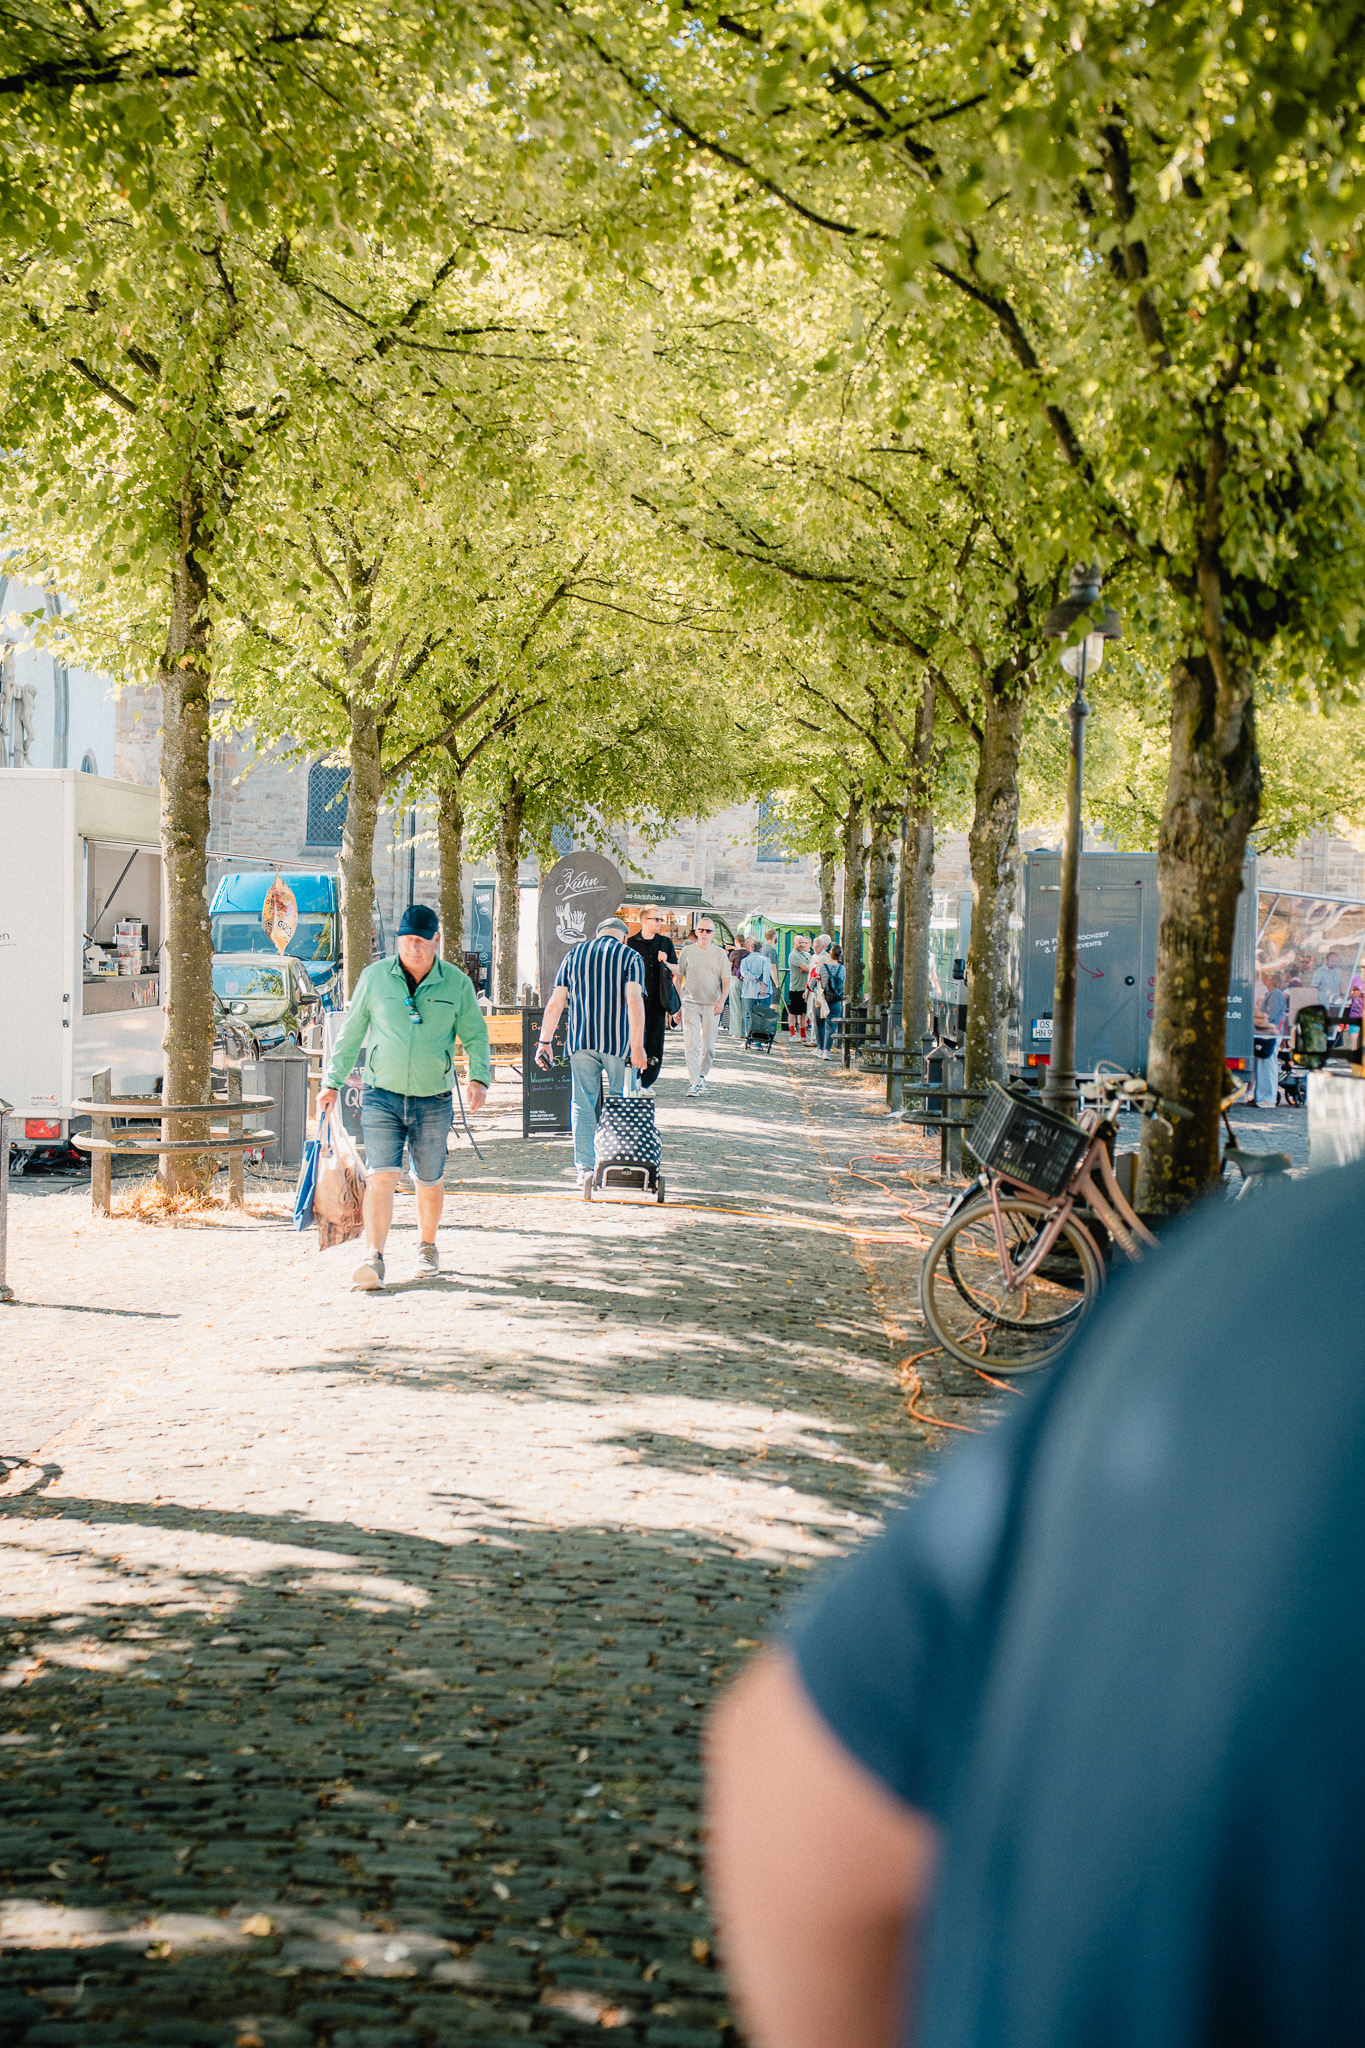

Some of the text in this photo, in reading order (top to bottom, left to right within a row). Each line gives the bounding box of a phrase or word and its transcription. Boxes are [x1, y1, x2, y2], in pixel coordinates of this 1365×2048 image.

[476, 893, 490, 904] MOIN
[1035, 939, 1050, 947] FÜR
[1040, 1020, 1051, 1029] OS
